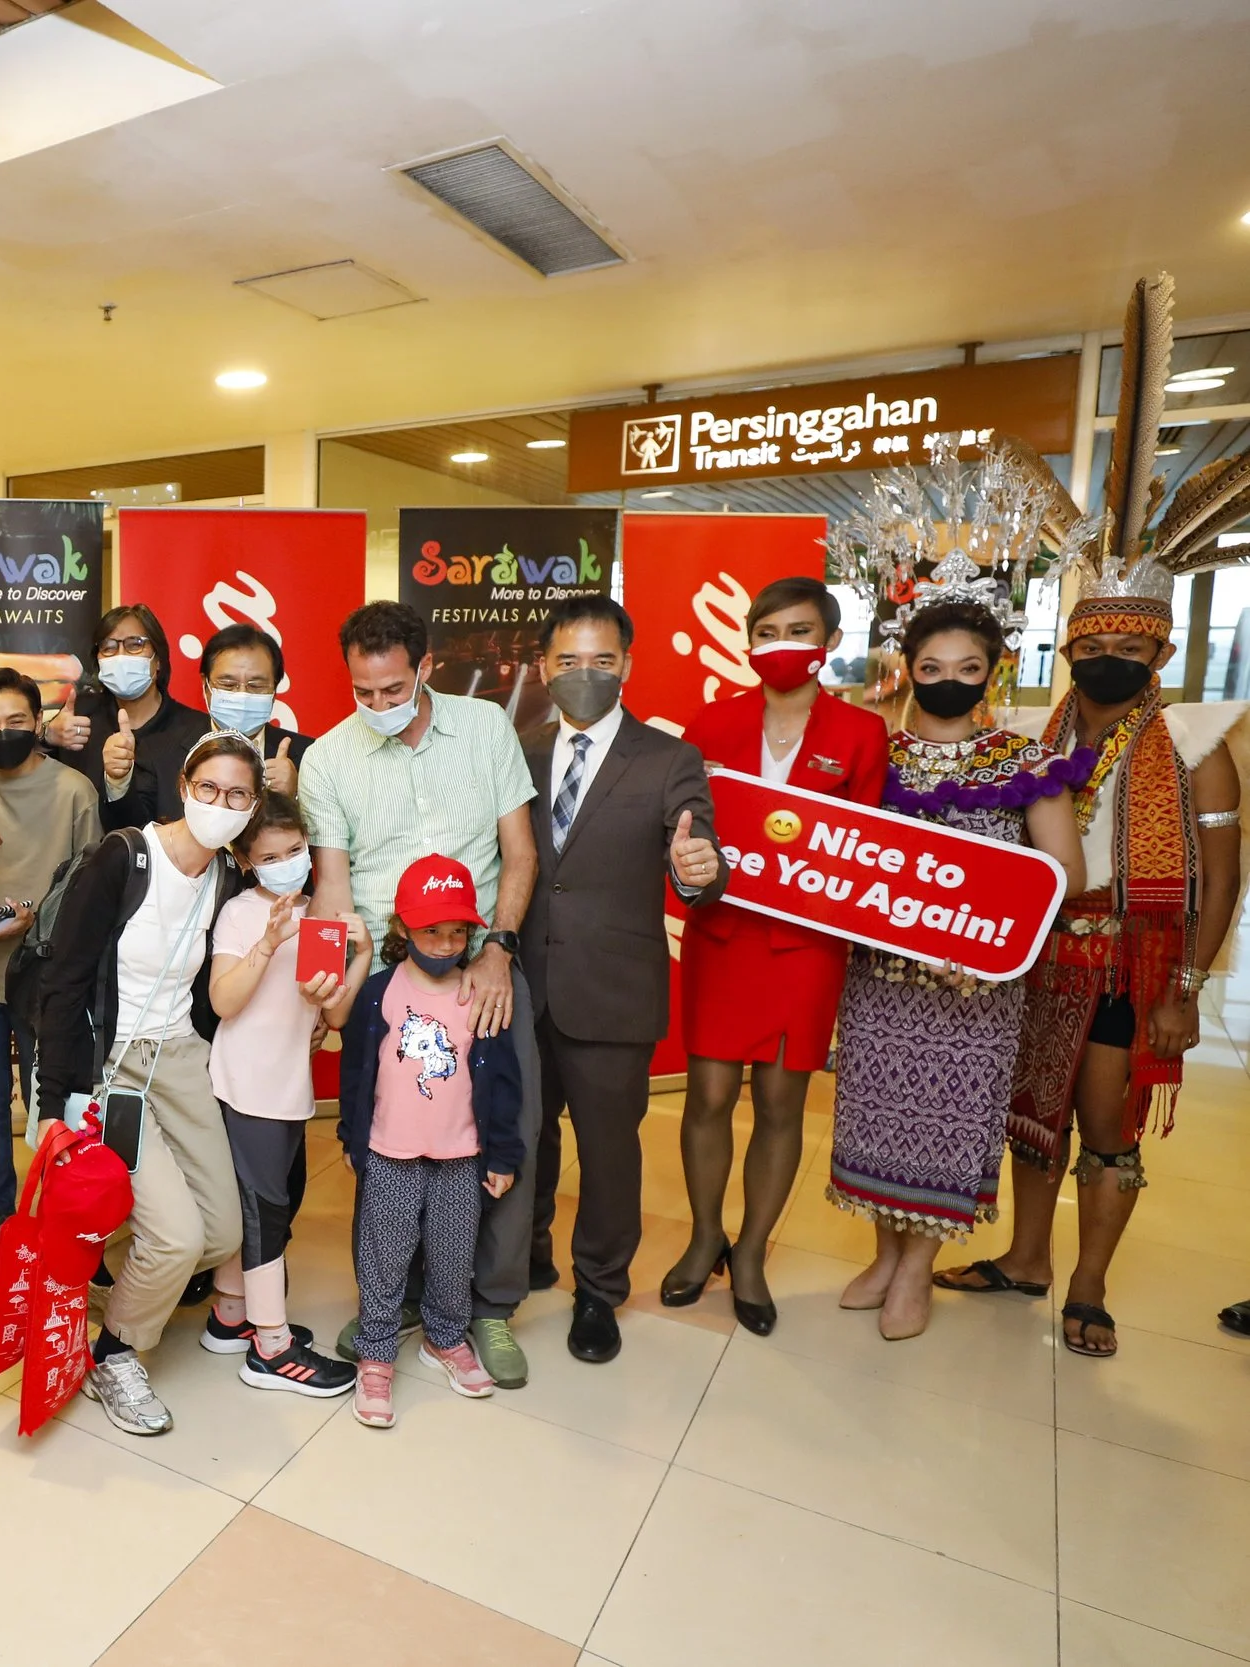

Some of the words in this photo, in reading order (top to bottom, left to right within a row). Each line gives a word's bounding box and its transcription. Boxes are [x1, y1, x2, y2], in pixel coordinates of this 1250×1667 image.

[690, 393, 937, 445] Persinggahan
[689, 441, 781, 470] Transit
[412, 538, 602, 586] Sarawak
[7, 587, 22, 600] to
[25, 587, 87, 601] Discover
[490, 587, 524, 600] More
[528, 587, 541, 600] to
[432, 608, 520, 623] FESTIVALS
[807, 822, 907, 874] Nice
[916, 852, 965, 889] to
[422, 874, 464, 895] AirAsia
[720, 845, 765, 877] ee
[777, 853, 854, 901] You
[856, 882, 1015, 948] Again!
